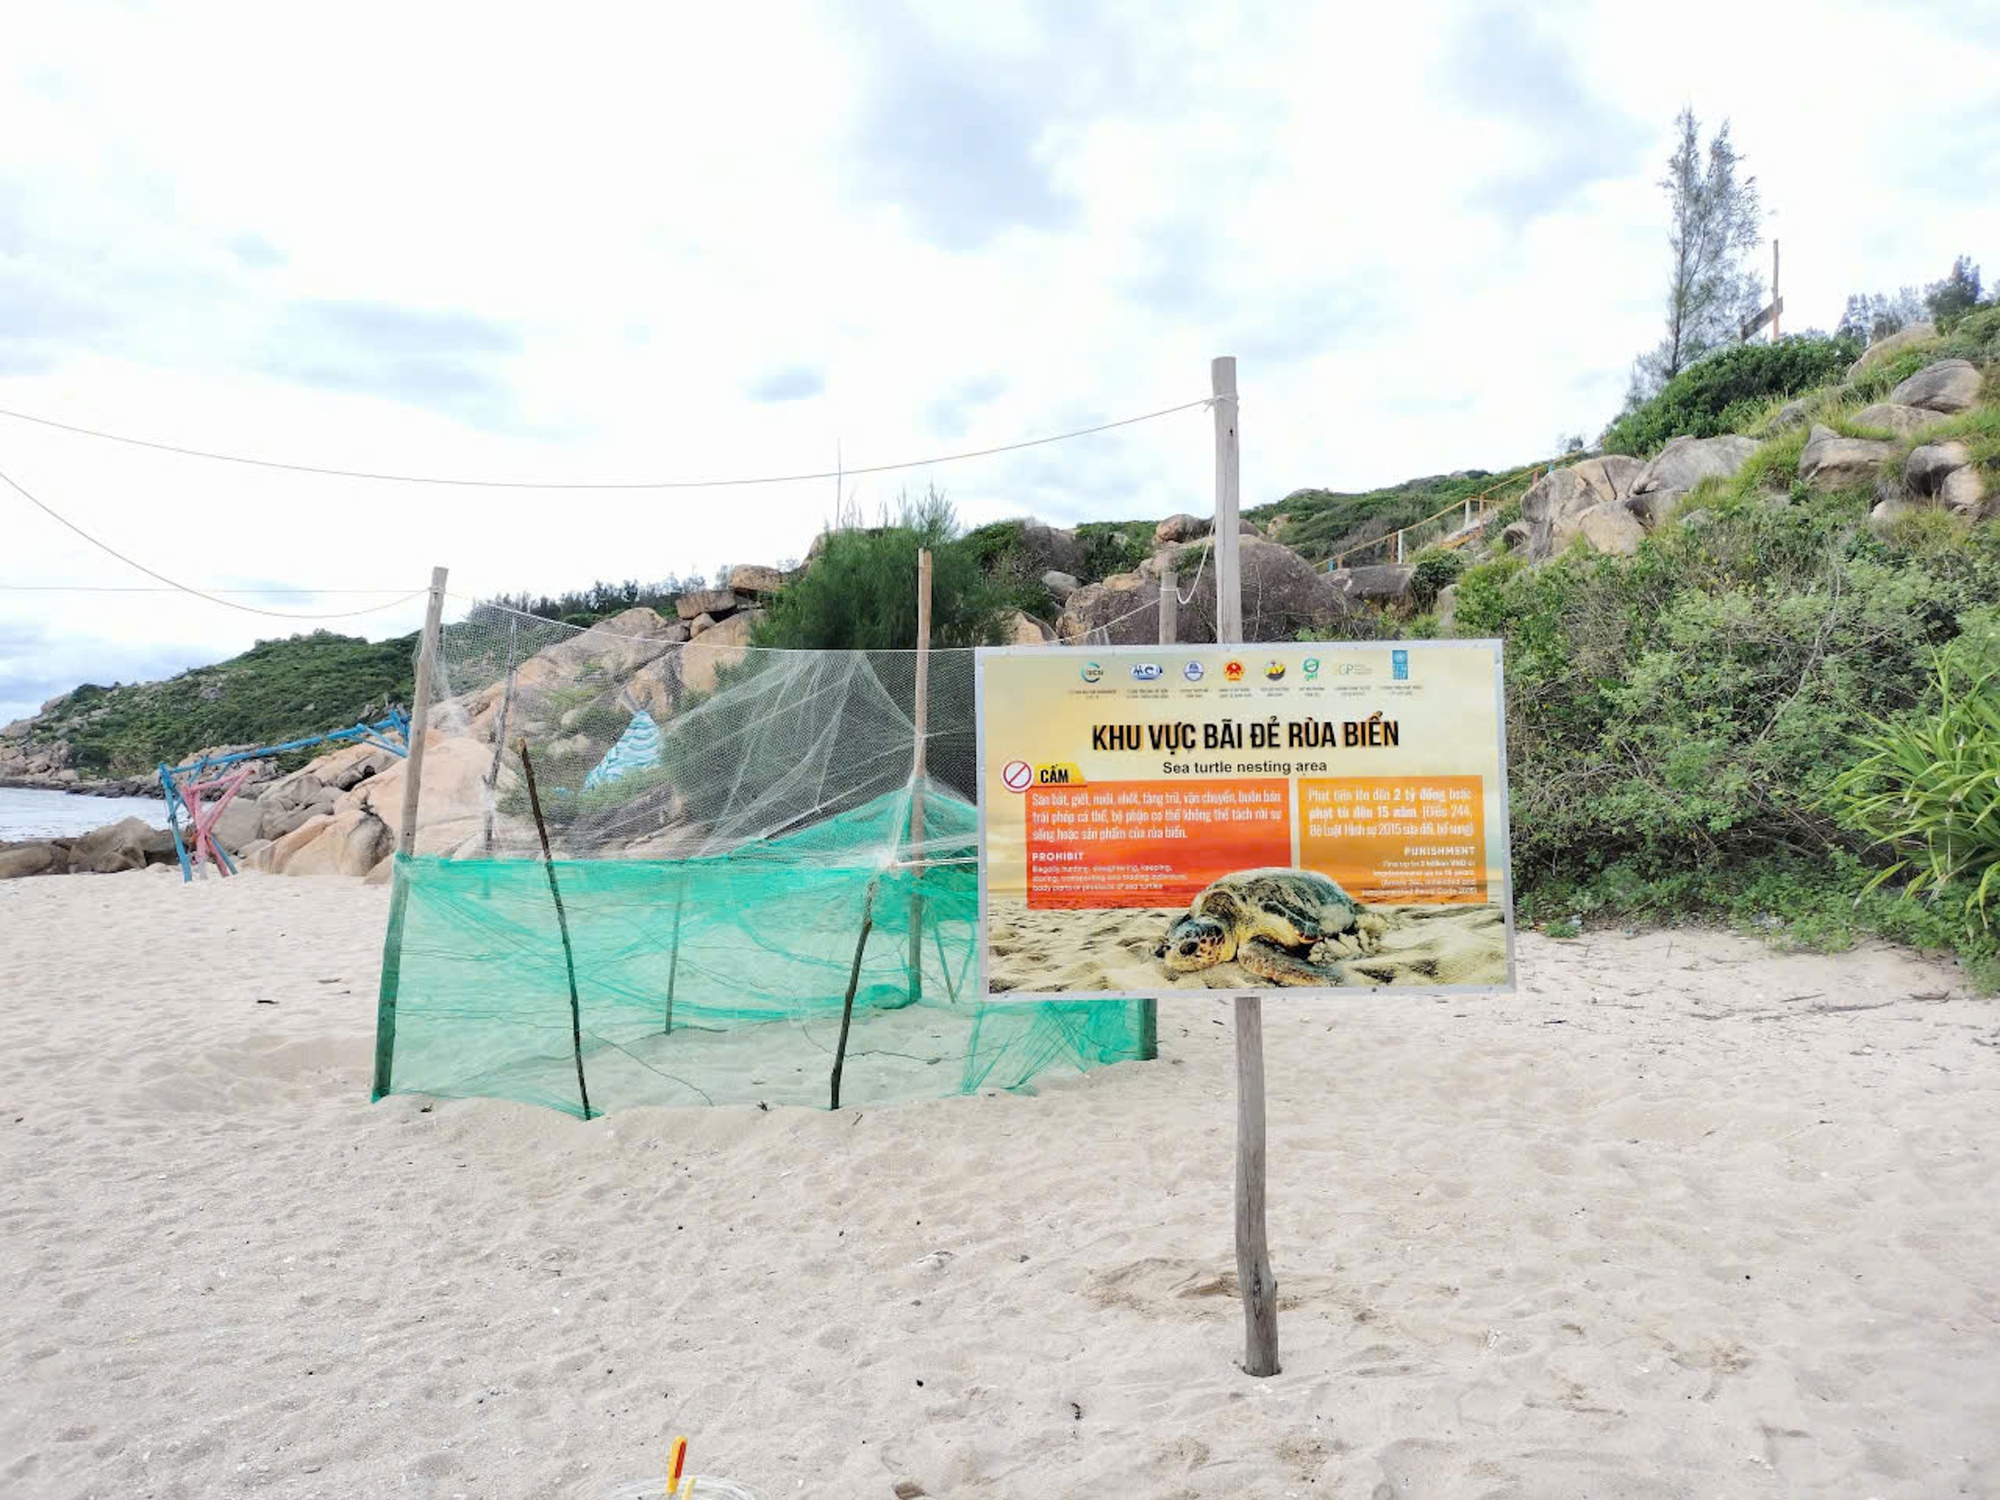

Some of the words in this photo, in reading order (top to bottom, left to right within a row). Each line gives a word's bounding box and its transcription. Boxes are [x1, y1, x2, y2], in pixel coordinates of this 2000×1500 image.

[1092, 724, 1142, 750] KHU
[1149, 721, 1196, 755] VỰC
[1203, 718, 1243, 750] BÃI
[1250, 715, 1281, 749] ĐẺ
[1288, 717, 1336, 748] RÙA
[1343, 710, 1399, 747] BIỂN
[1040, 763, 1069, 783] CẤM
[1163, 761, 1190, 774] Sea
[1194, 761, 1232, 773] turtle
[1237, 760, 1291, 775] nesting
[1296, 762, 1327, 772] area
[1393, 788, 1401, 801] 2
[1378, 805, 1389, 819] 15
[1378, 822, 1402, 836] 2015
[1031, 851, 1084, 861] PROHIBIT
[1404, 846, 1475, 856] PUNISHMENT
